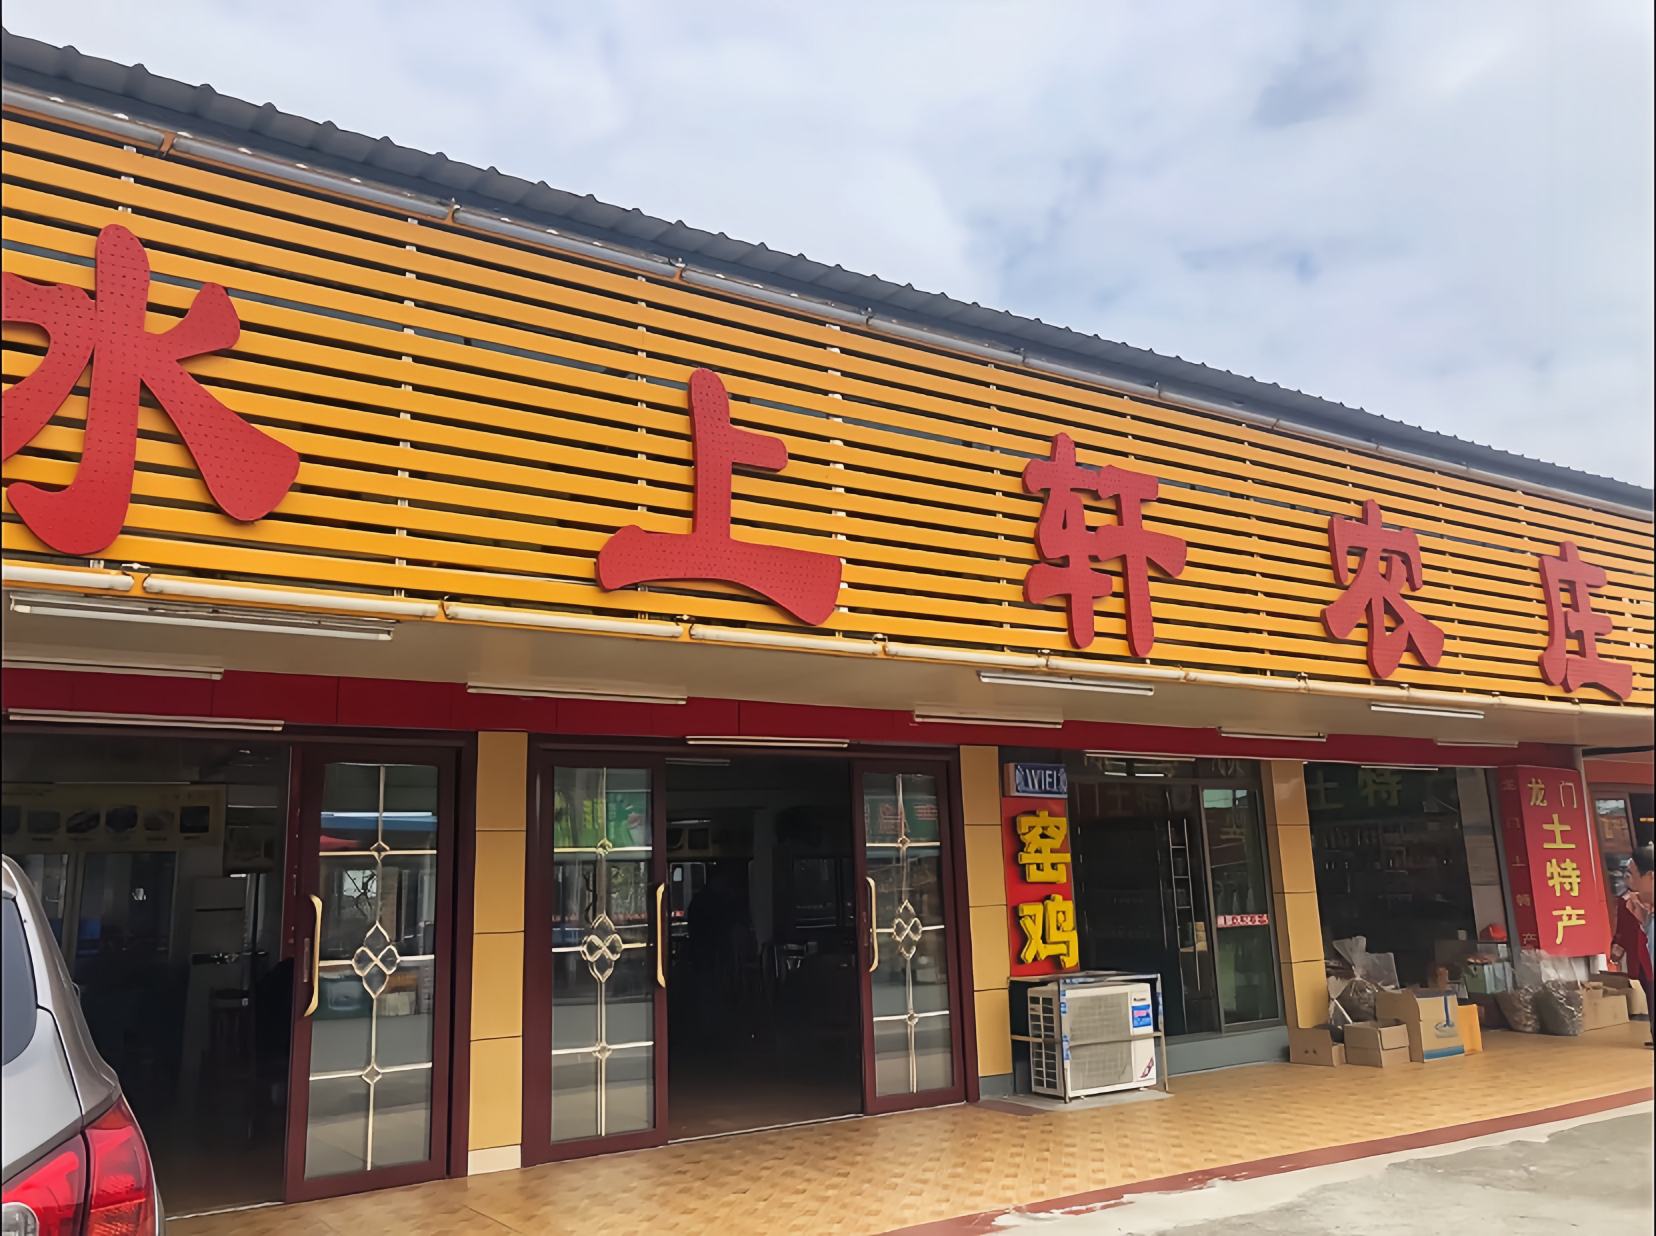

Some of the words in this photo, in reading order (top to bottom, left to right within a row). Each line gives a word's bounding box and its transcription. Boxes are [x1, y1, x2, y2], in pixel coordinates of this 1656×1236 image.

[2, 224, 1633, 702] 水上轩农庄
[1527, 777, 1578, 809] 龙门
[1016, 809, 1079, 969] 窑鸡
[1542, 813, 1586, 945] 土特产
